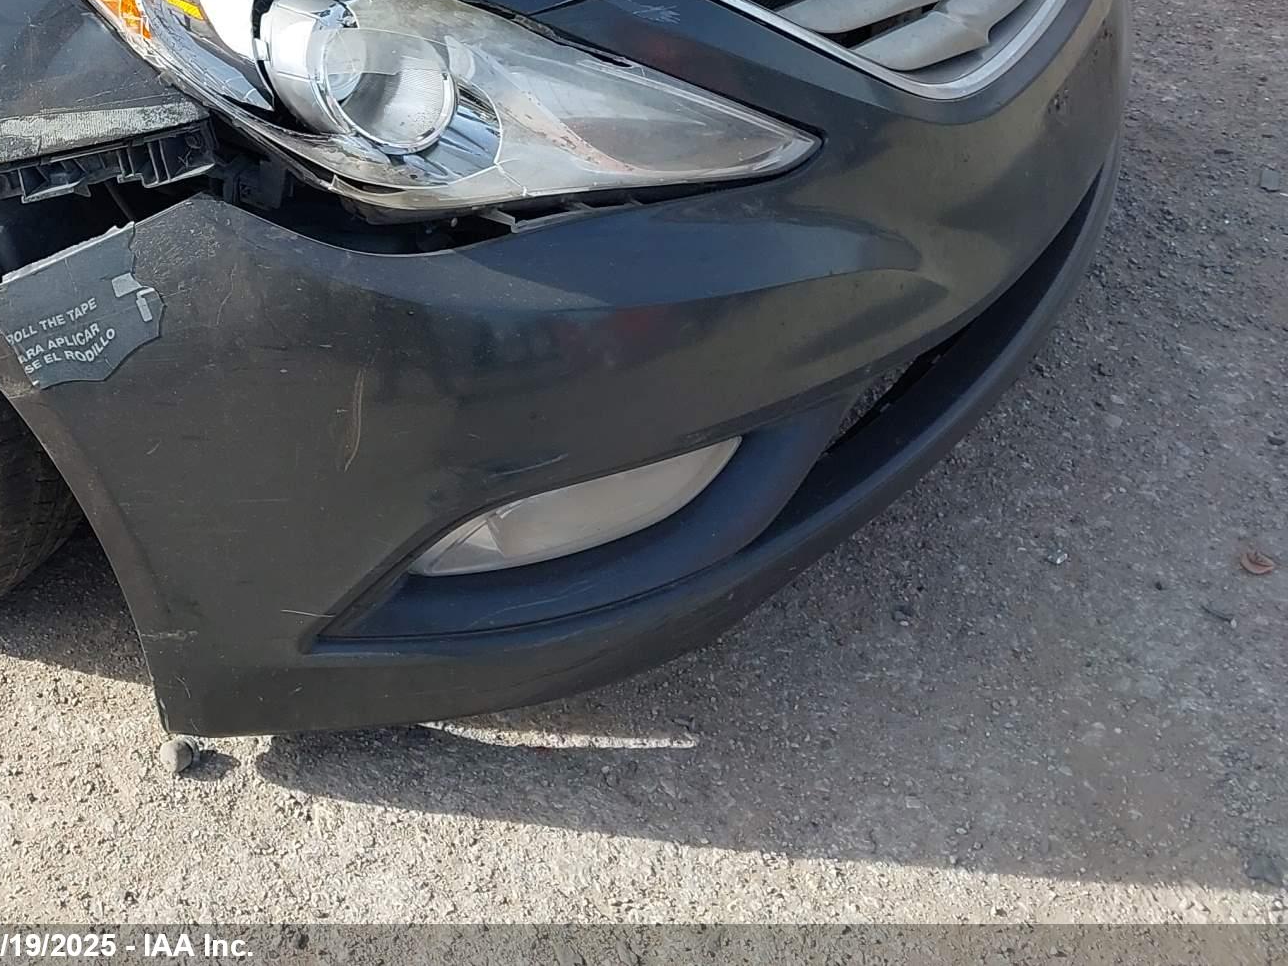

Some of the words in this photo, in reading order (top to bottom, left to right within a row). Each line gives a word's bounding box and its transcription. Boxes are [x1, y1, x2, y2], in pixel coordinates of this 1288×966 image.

[39, 314, 66, 331] THE
[66, 297, 97, 322] TAPE
[24, 359, 43, 375] SE
[43, 352, 62, 365] EL
[64, 328, 116, 362] RODILLO
[48, 322, 101, 350] APLICAR
